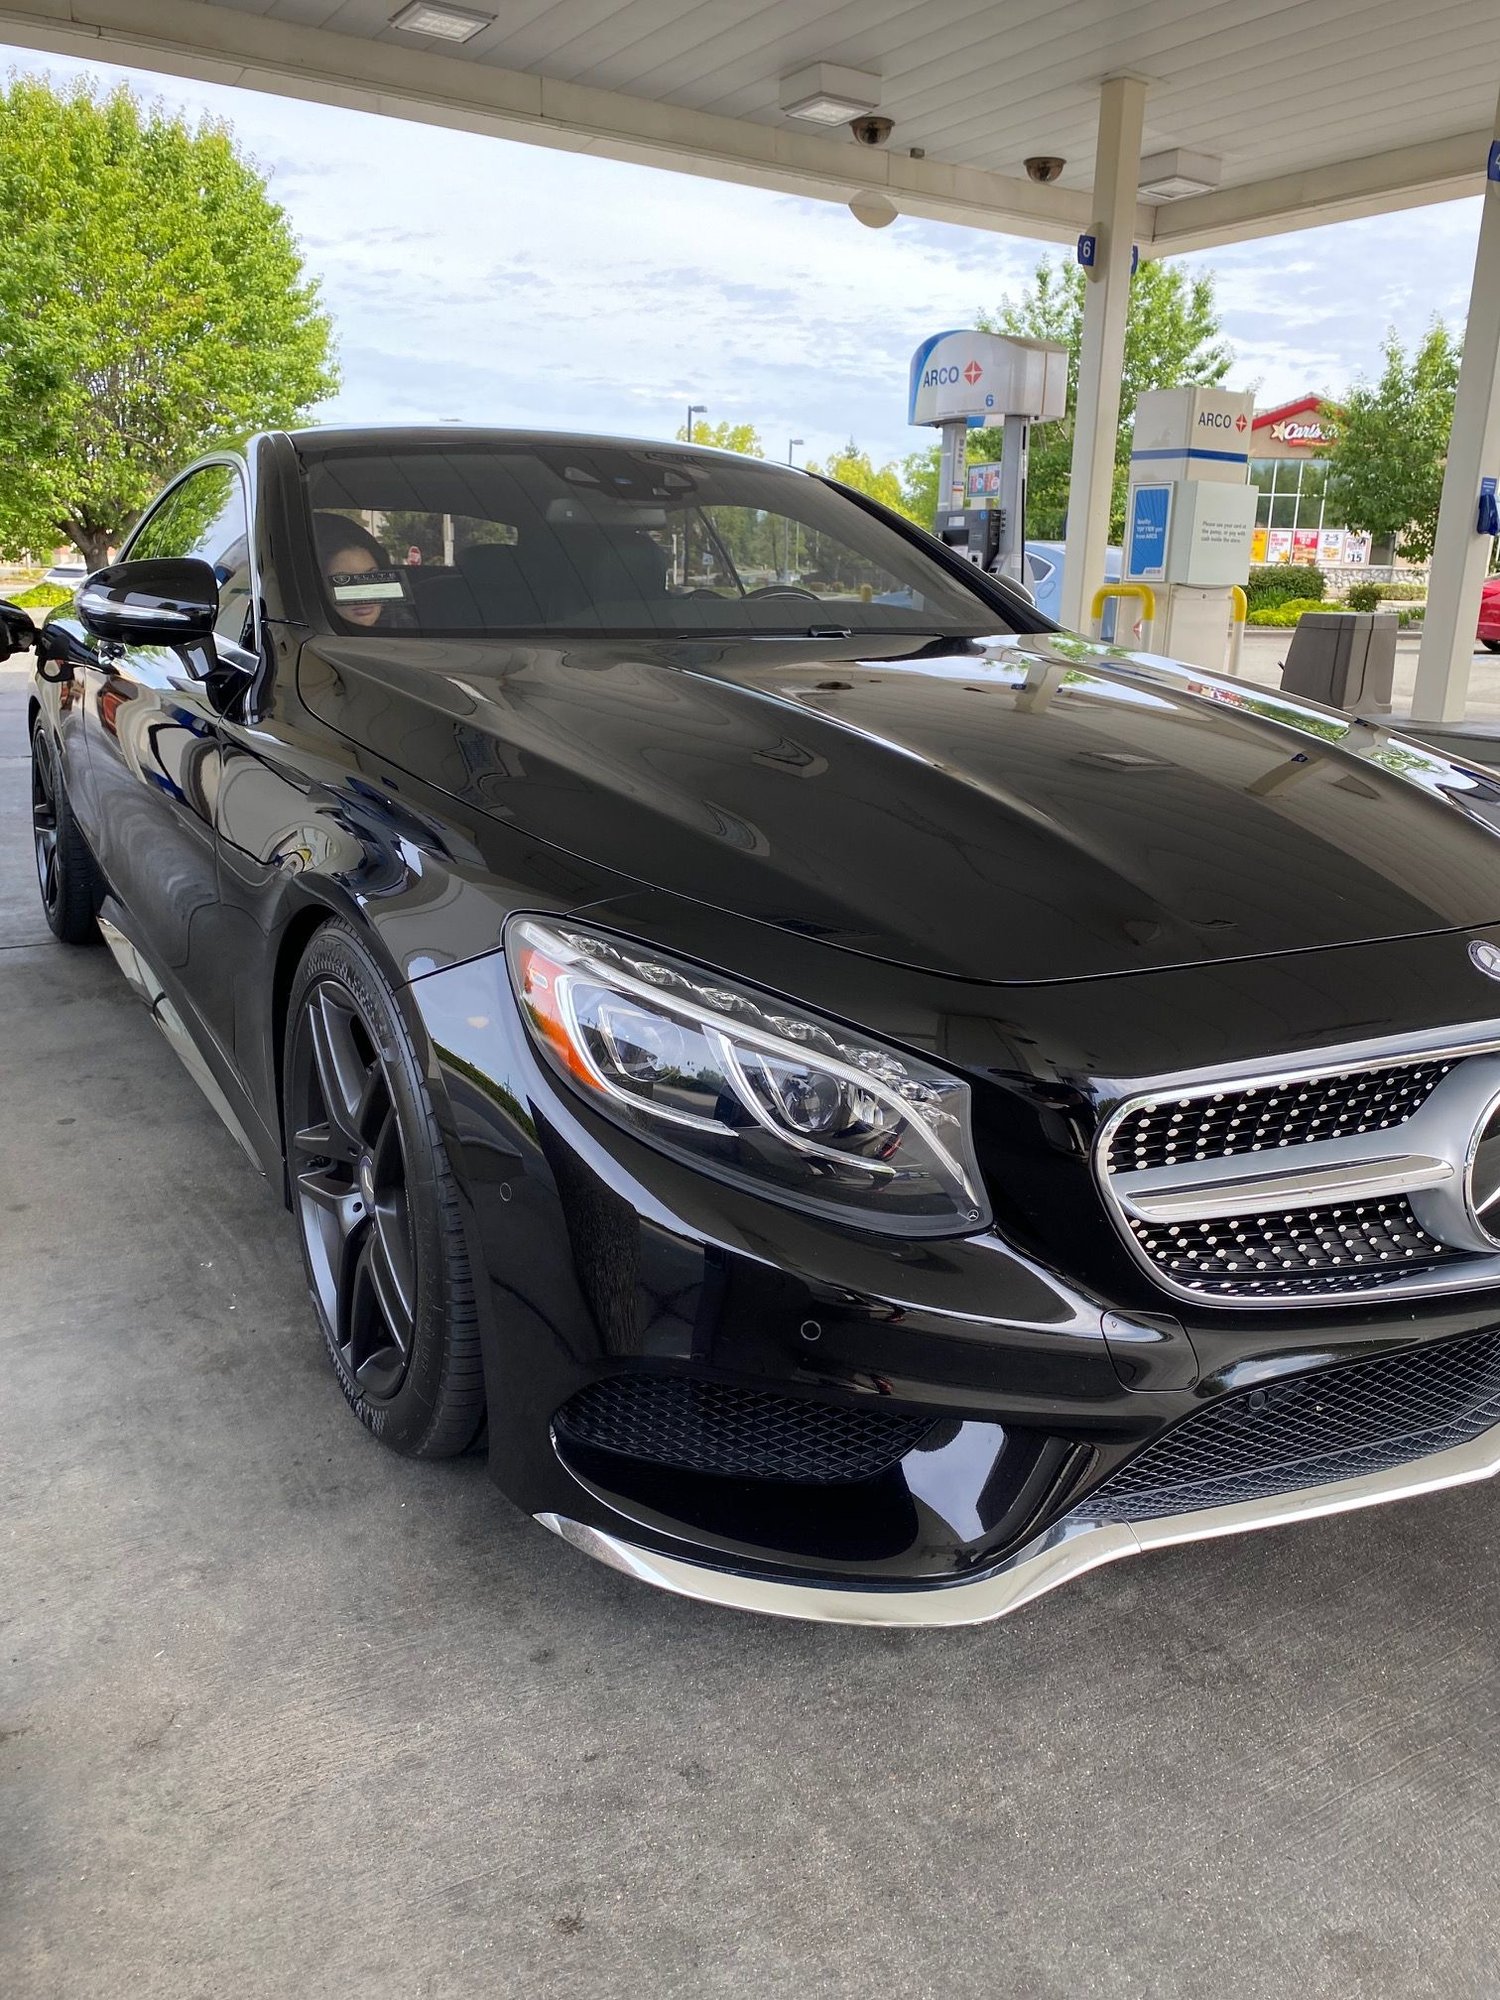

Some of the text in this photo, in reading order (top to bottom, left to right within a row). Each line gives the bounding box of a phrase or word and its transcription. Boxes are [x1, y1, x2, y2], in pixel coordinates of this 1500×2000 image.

[1082, 240, 1091, 258] 6
[923, 366, 959, 388] ARCO
[985, 395, 994, 407] 6
[1198, 412, 1232, 429] ARCO
[1284, 423, 1322, 440] Carl's
